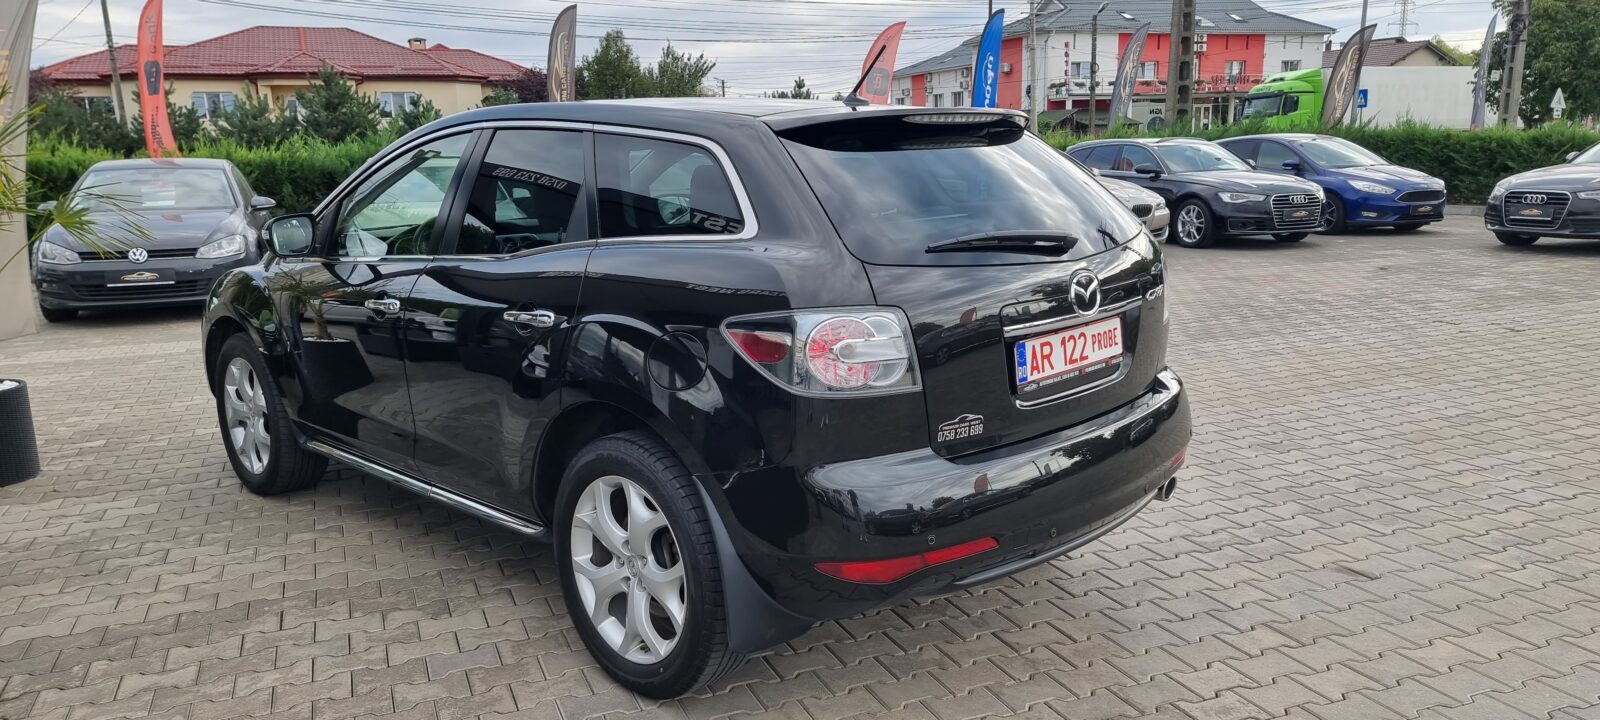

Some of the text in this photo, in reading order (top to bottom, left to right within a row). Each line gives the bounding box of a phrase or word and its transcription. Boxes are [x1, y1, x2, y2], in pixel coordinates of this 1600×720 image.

[1030, 341, 1054, 376] AR
[1061, 332, 1089, 366] 122
[1091, 327, 1119, 352] PROBE
[1018, 365, 1028, 379] RO
[937, 424, 984, 442] 0758 233 699
